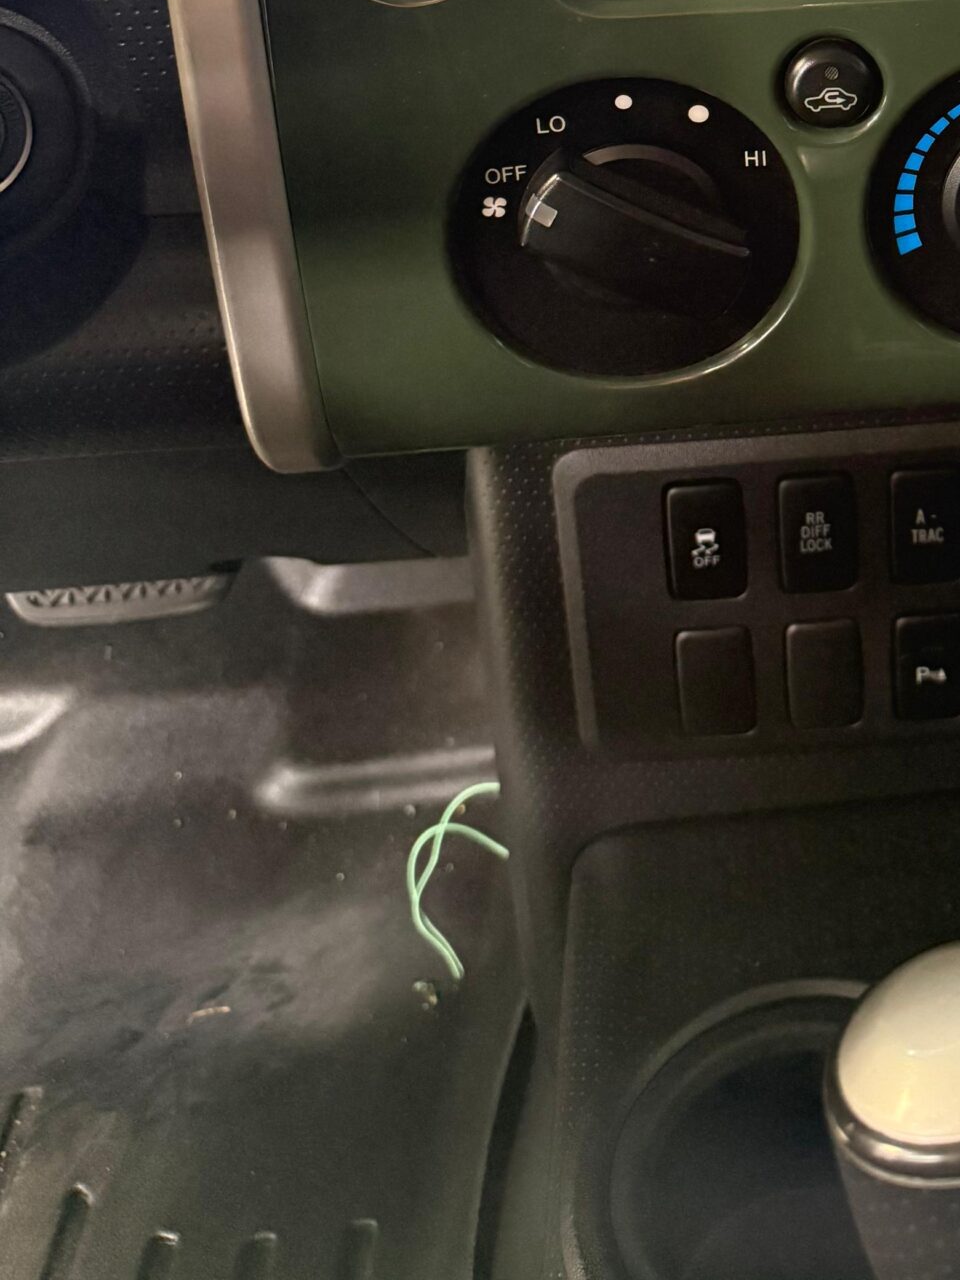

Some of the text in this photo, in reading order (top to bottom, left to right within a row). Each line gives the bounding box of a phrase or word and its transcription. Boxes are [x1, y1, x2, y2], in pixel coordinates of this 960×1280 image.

[536, 115, 566, 134] LO
[744, 150, 767, 167] HI
[485, 164, 528, 185] OFF
[805, 511, 825, 524] RR
[800, 524, 831, 539] DIFF
[911, 527, 945, 545] TRAC
[800, 538, 833, 555] LOCK
[692, 555, 721, 569] OFF
